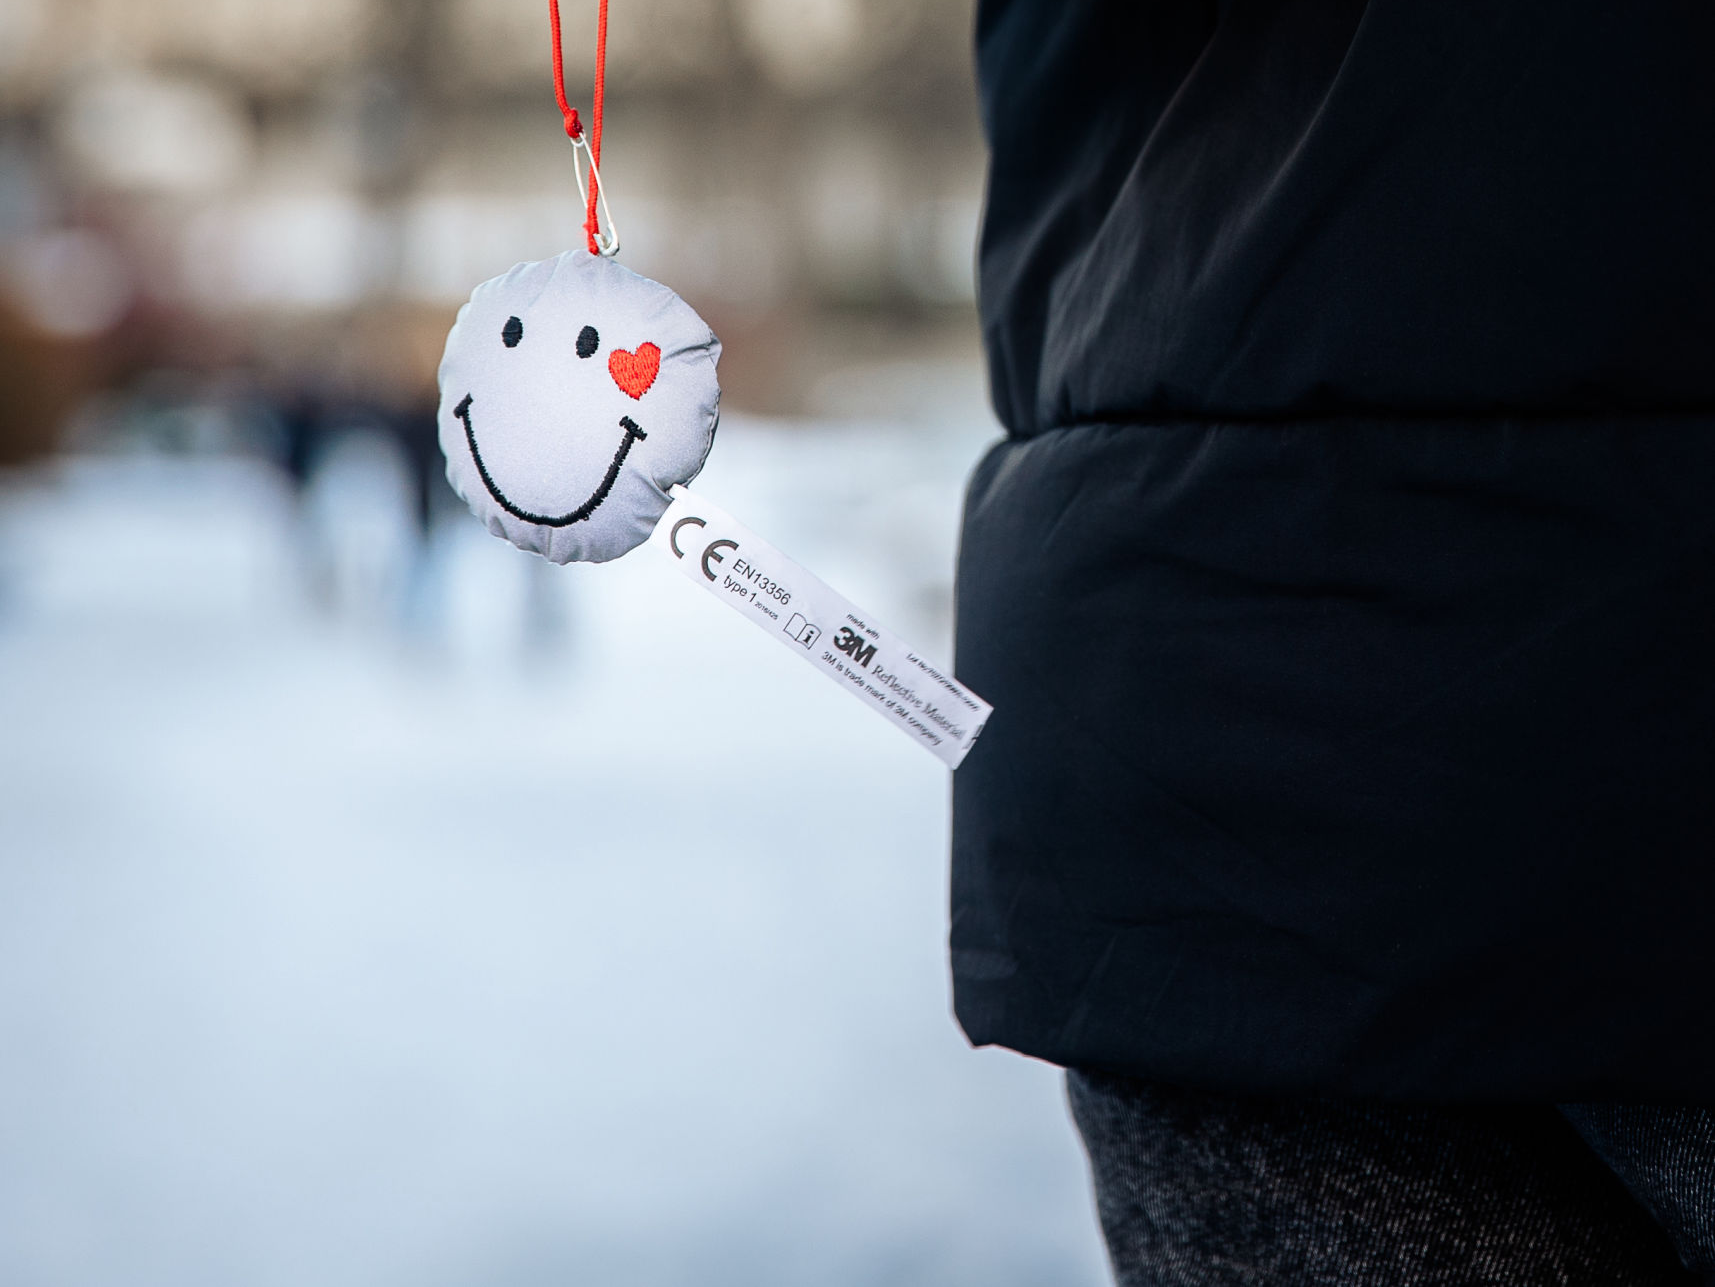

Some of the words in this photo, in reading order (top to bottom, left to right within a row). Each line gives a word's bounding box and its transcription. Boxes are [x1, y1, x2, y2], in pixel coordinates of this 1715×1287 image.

[670, 517, 740, 582] CE
[723, 574, 748, 597] type
[749, 592, 757, 603] 1
[732, 559, 792, 606] EN13356
[846, 613, 866, 630] made
[865, 628, 880, 640] with
[821, 651, 837, 666] 3M
[836, 660, 844, 672] is
[844, 667, 865, 687] trade
[864, 684, 886, 702] mark
[833, 626, 878, 668] 3M
[871, 664, 923, 709] Reflective
